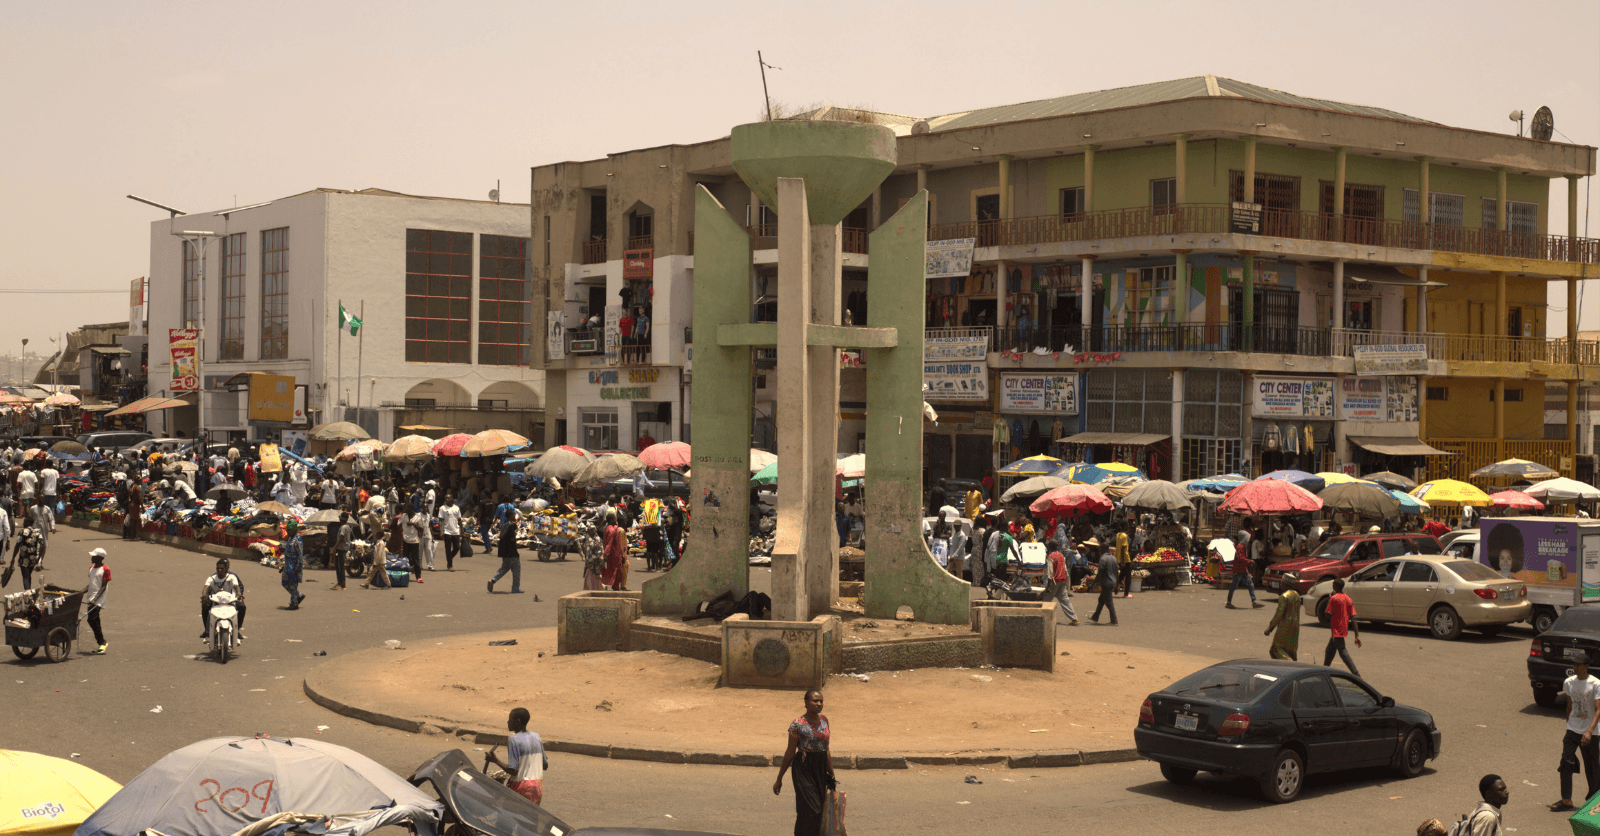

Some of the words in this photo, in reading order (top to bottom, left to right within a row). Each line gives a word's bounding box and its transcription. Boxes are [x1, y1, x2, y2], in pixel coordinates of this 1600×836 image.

[171, 329, 196, 339] Kellogg's
[946, 364, 958, 374] BOOK
[959, 364, 971, 374] SHOP
[629, 369, 659, 383] SHARP
[1005, 378, 1018, 389] CITY
[1021, 378, 1044, 389] CENTER
[1260, 382, 1275, 393] CITY
[1277, 382, 1302, 394] CENTER
[1343, 379, 1356, 391] CITY
[1358, 379, 1382, 392] CENTER
[600, 387, 650, 399] COLLECTION
[256, 400, 290, 410] GTBank
[1344, 465, 1355, 474] POS
[21, 803, 65, 818] Biotol
